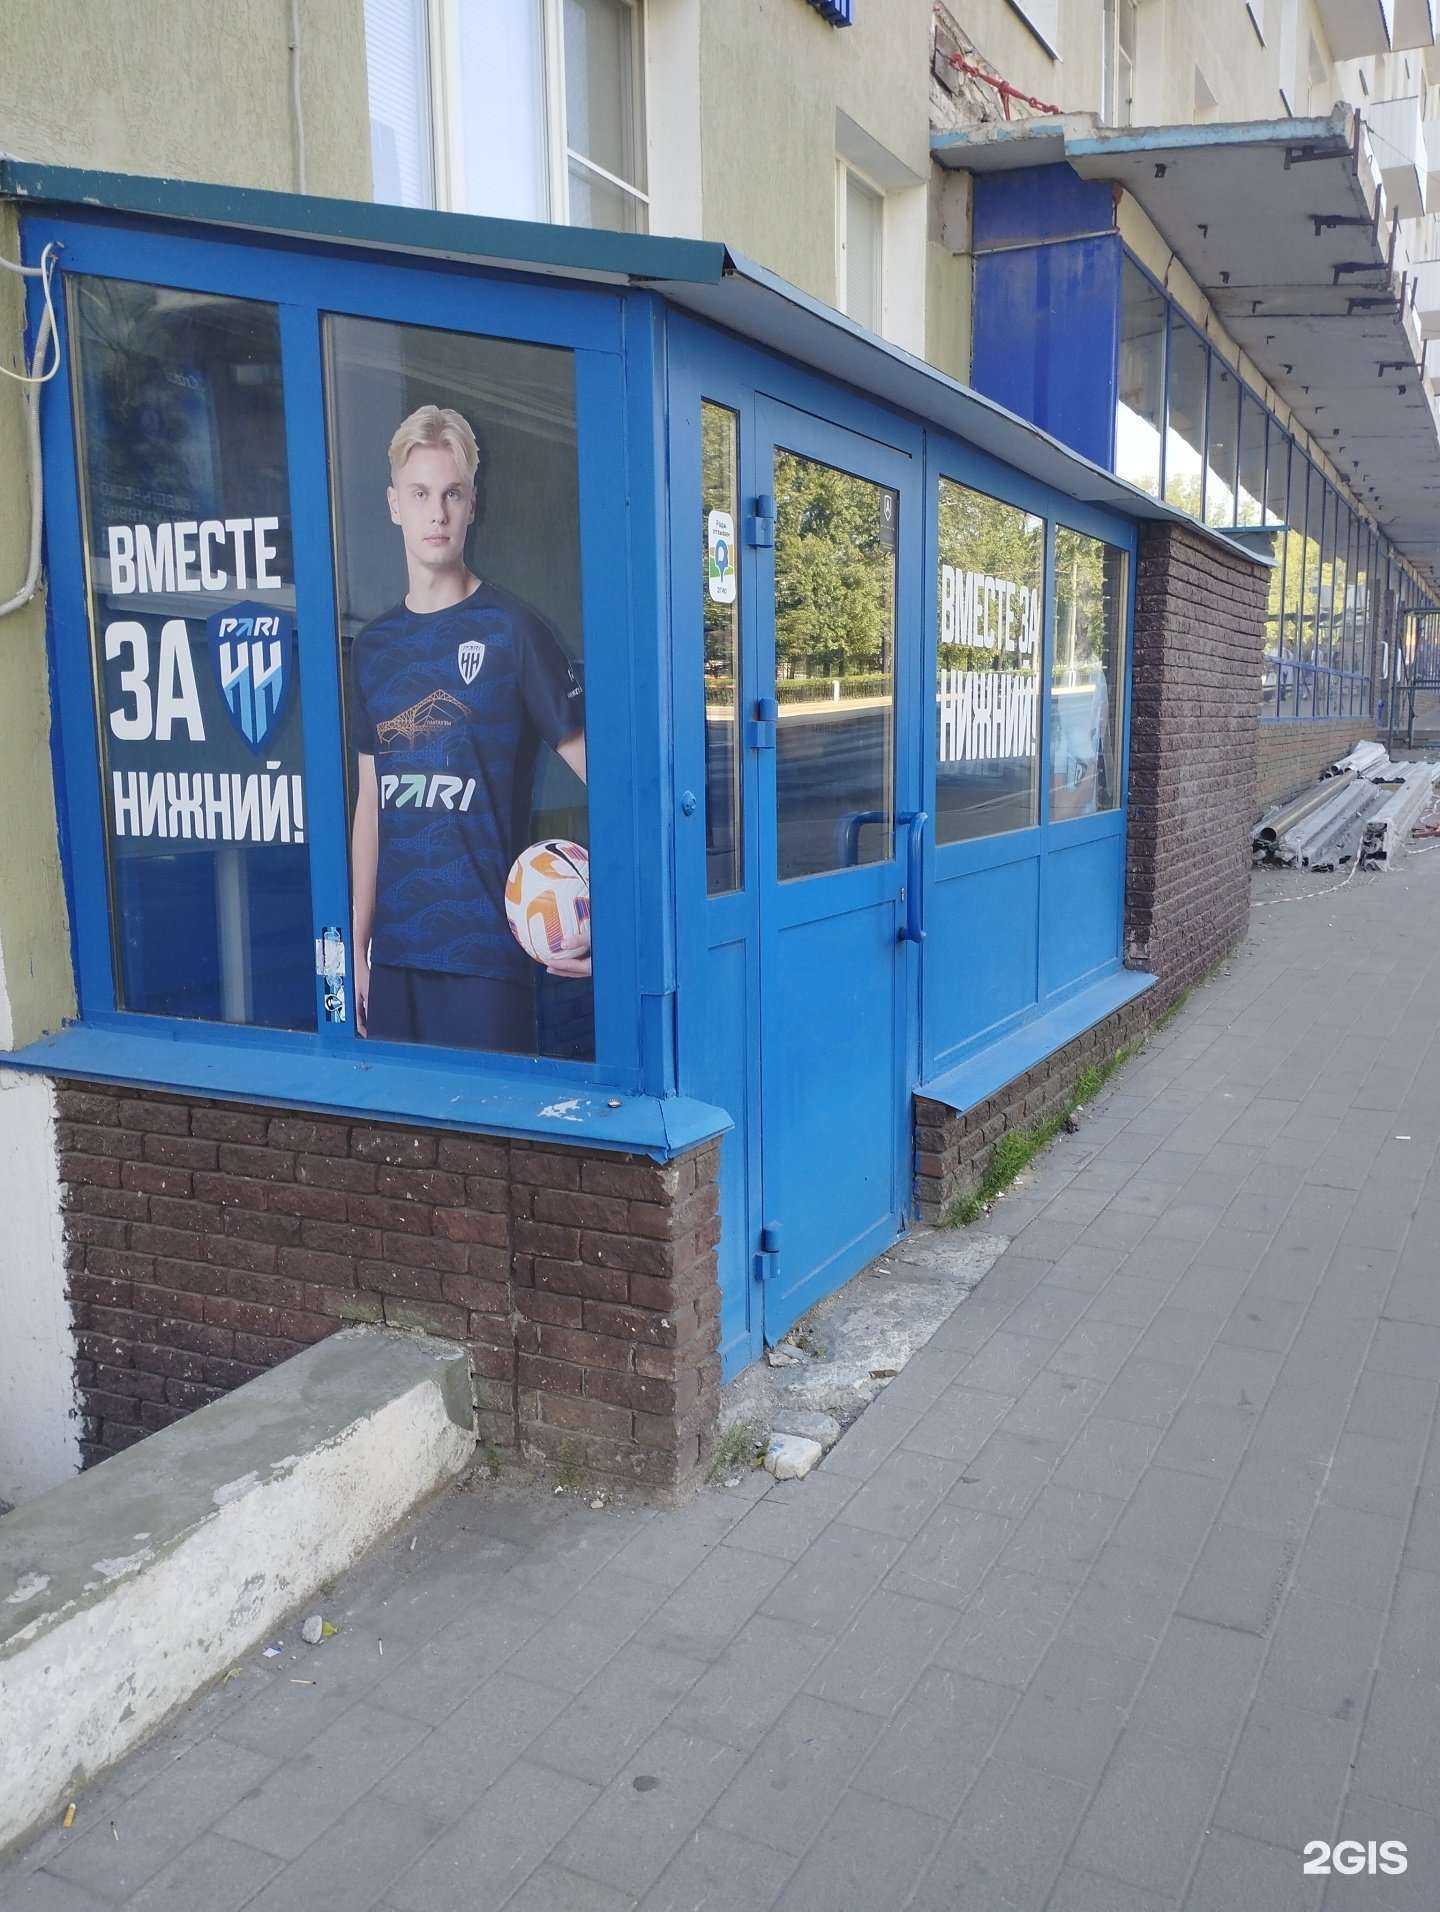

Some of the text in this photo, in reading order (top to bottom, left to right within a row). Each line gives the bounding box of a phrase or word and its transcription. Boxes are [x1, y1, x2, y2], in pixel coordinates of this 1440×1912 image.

[108, 516, 281, 594] ВМЕСТЕ
[219, 616, 280, 637] PARI
[941, 564, 1039, 655] ВМЕСТЕ ЗА
[105, 619, 205, 741] ЗА
[940, 660, 1037, 762] НИЖНИЙ!
[112, 761, 304, 844] НИЖНИЙ!
[381, 774, 476, 812] PARI
